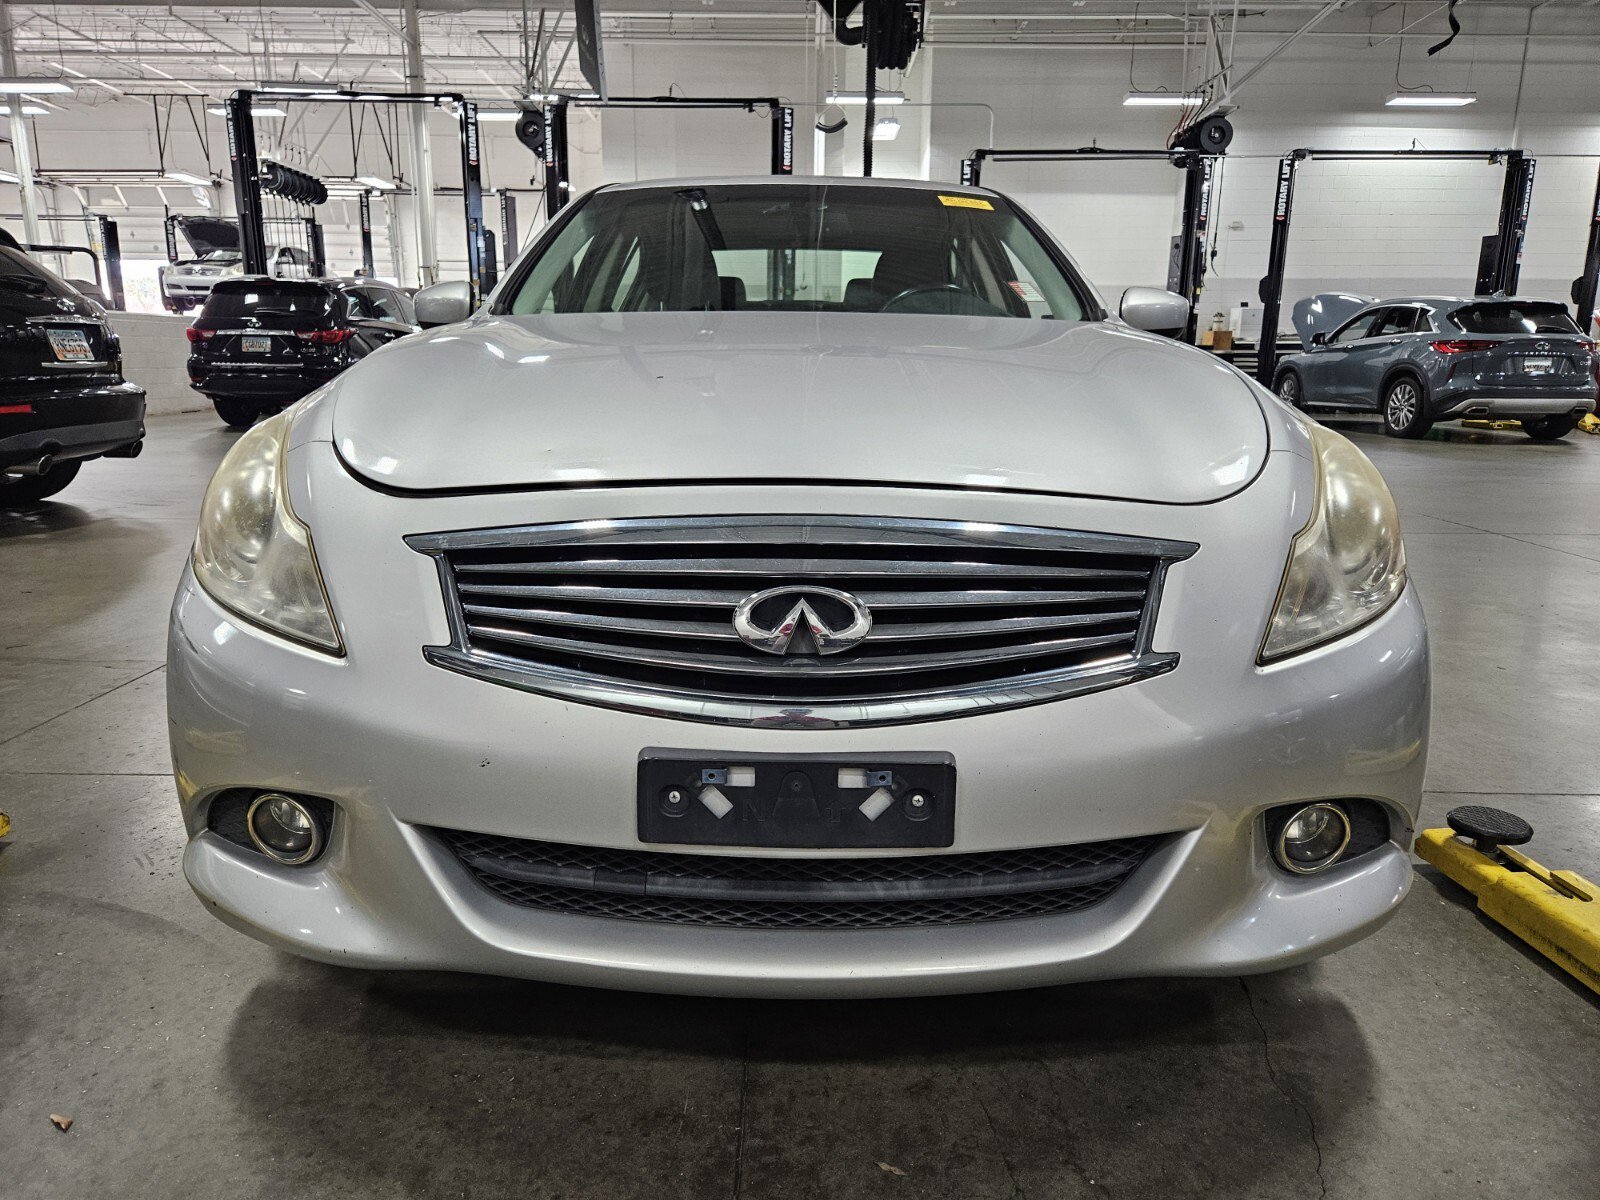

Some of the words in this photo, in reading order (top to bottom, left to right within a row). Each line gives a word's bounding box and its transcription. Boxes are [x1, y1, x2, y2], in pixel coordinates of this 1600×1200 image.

[467, 103, 475, 122] LIFT
[544, 104, 552, 124] LIFT
[784, 108, 792, 127] LIFT
[468, 124, 477, 160] ROTARY
[545, 126, 553, 161] ROTARY
[784, 130, 792, 165] ROTARY
[962, 160, 971, 178] LIFT
[1203, 158, 1211, 178] LIFT
[1282, 160, 1291, 178] LIFT
[1201, 180, 1210, 216] ROTARY
[1277, 181, 1288, 215] ROTARY
[1522, 180, 1531, 215] ROTARY
